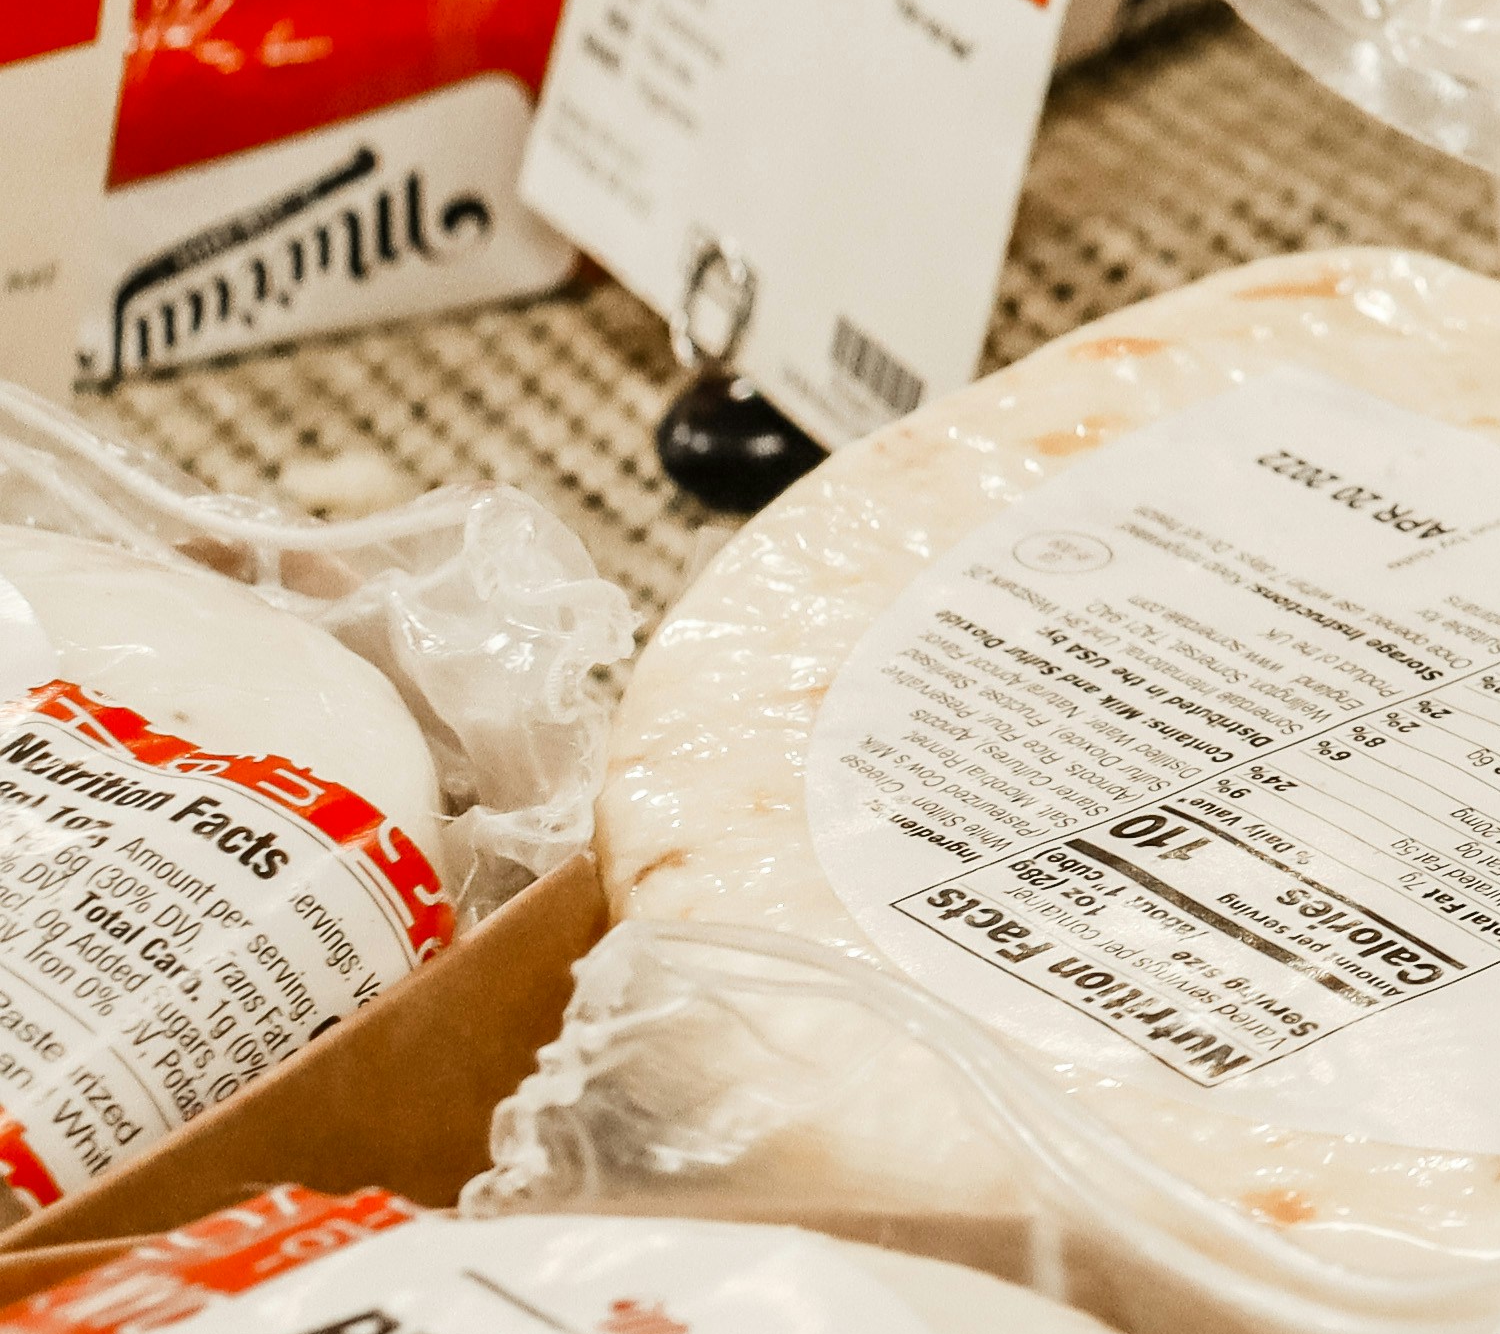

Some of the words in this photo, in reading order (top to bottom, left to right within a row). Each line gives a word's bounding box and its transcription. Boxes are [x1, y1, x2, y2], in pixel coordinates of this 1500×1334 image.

[1256, 449, 1339, 488] 2022
[1330, 485, 1382, 509] 20
[1371, 503, 1449, 539] APR
[1250, 582, 1366, 641] Instructions:
[1364, 638, 1444, 681] Storage
[1466, 748, 1494, 767] 6g
[0, 731, 176, 812] Nutrition
[168, 795, 289, 880] Facts
[294, 894, 359, 975] ervings:
[1108, 813, 1212, 861] 110
[1389, 837, 1420, 856] 5g
[1006, 858, 1070, 891] (28g
[1398, 872, 1426, 891] 7g
[1411, 851, 1451, 872] Fat
[1059, 886, 1107, 916] 1oz
[1215, 892, 1290, 934] serving
[1420, 887, 1467, 914] Fat
[114, 836, 217, 905] Amount
[248, 933, 318, 1026] serving:
[925, 887, 1054, 964] Facts
[1275, 888, 1443, 985] Calories
[1286, 932, 1331, 953] per
[72, 890, 147, 945] Total
[206, 999, 238, 1040] 1g
[1169, 950, 1216, 978] size
[1334, 955, 1405, 997] Amount
[1047, 955, 1252, 1078] Nutrition
[1221, 976, 1319, 1037] Serving
